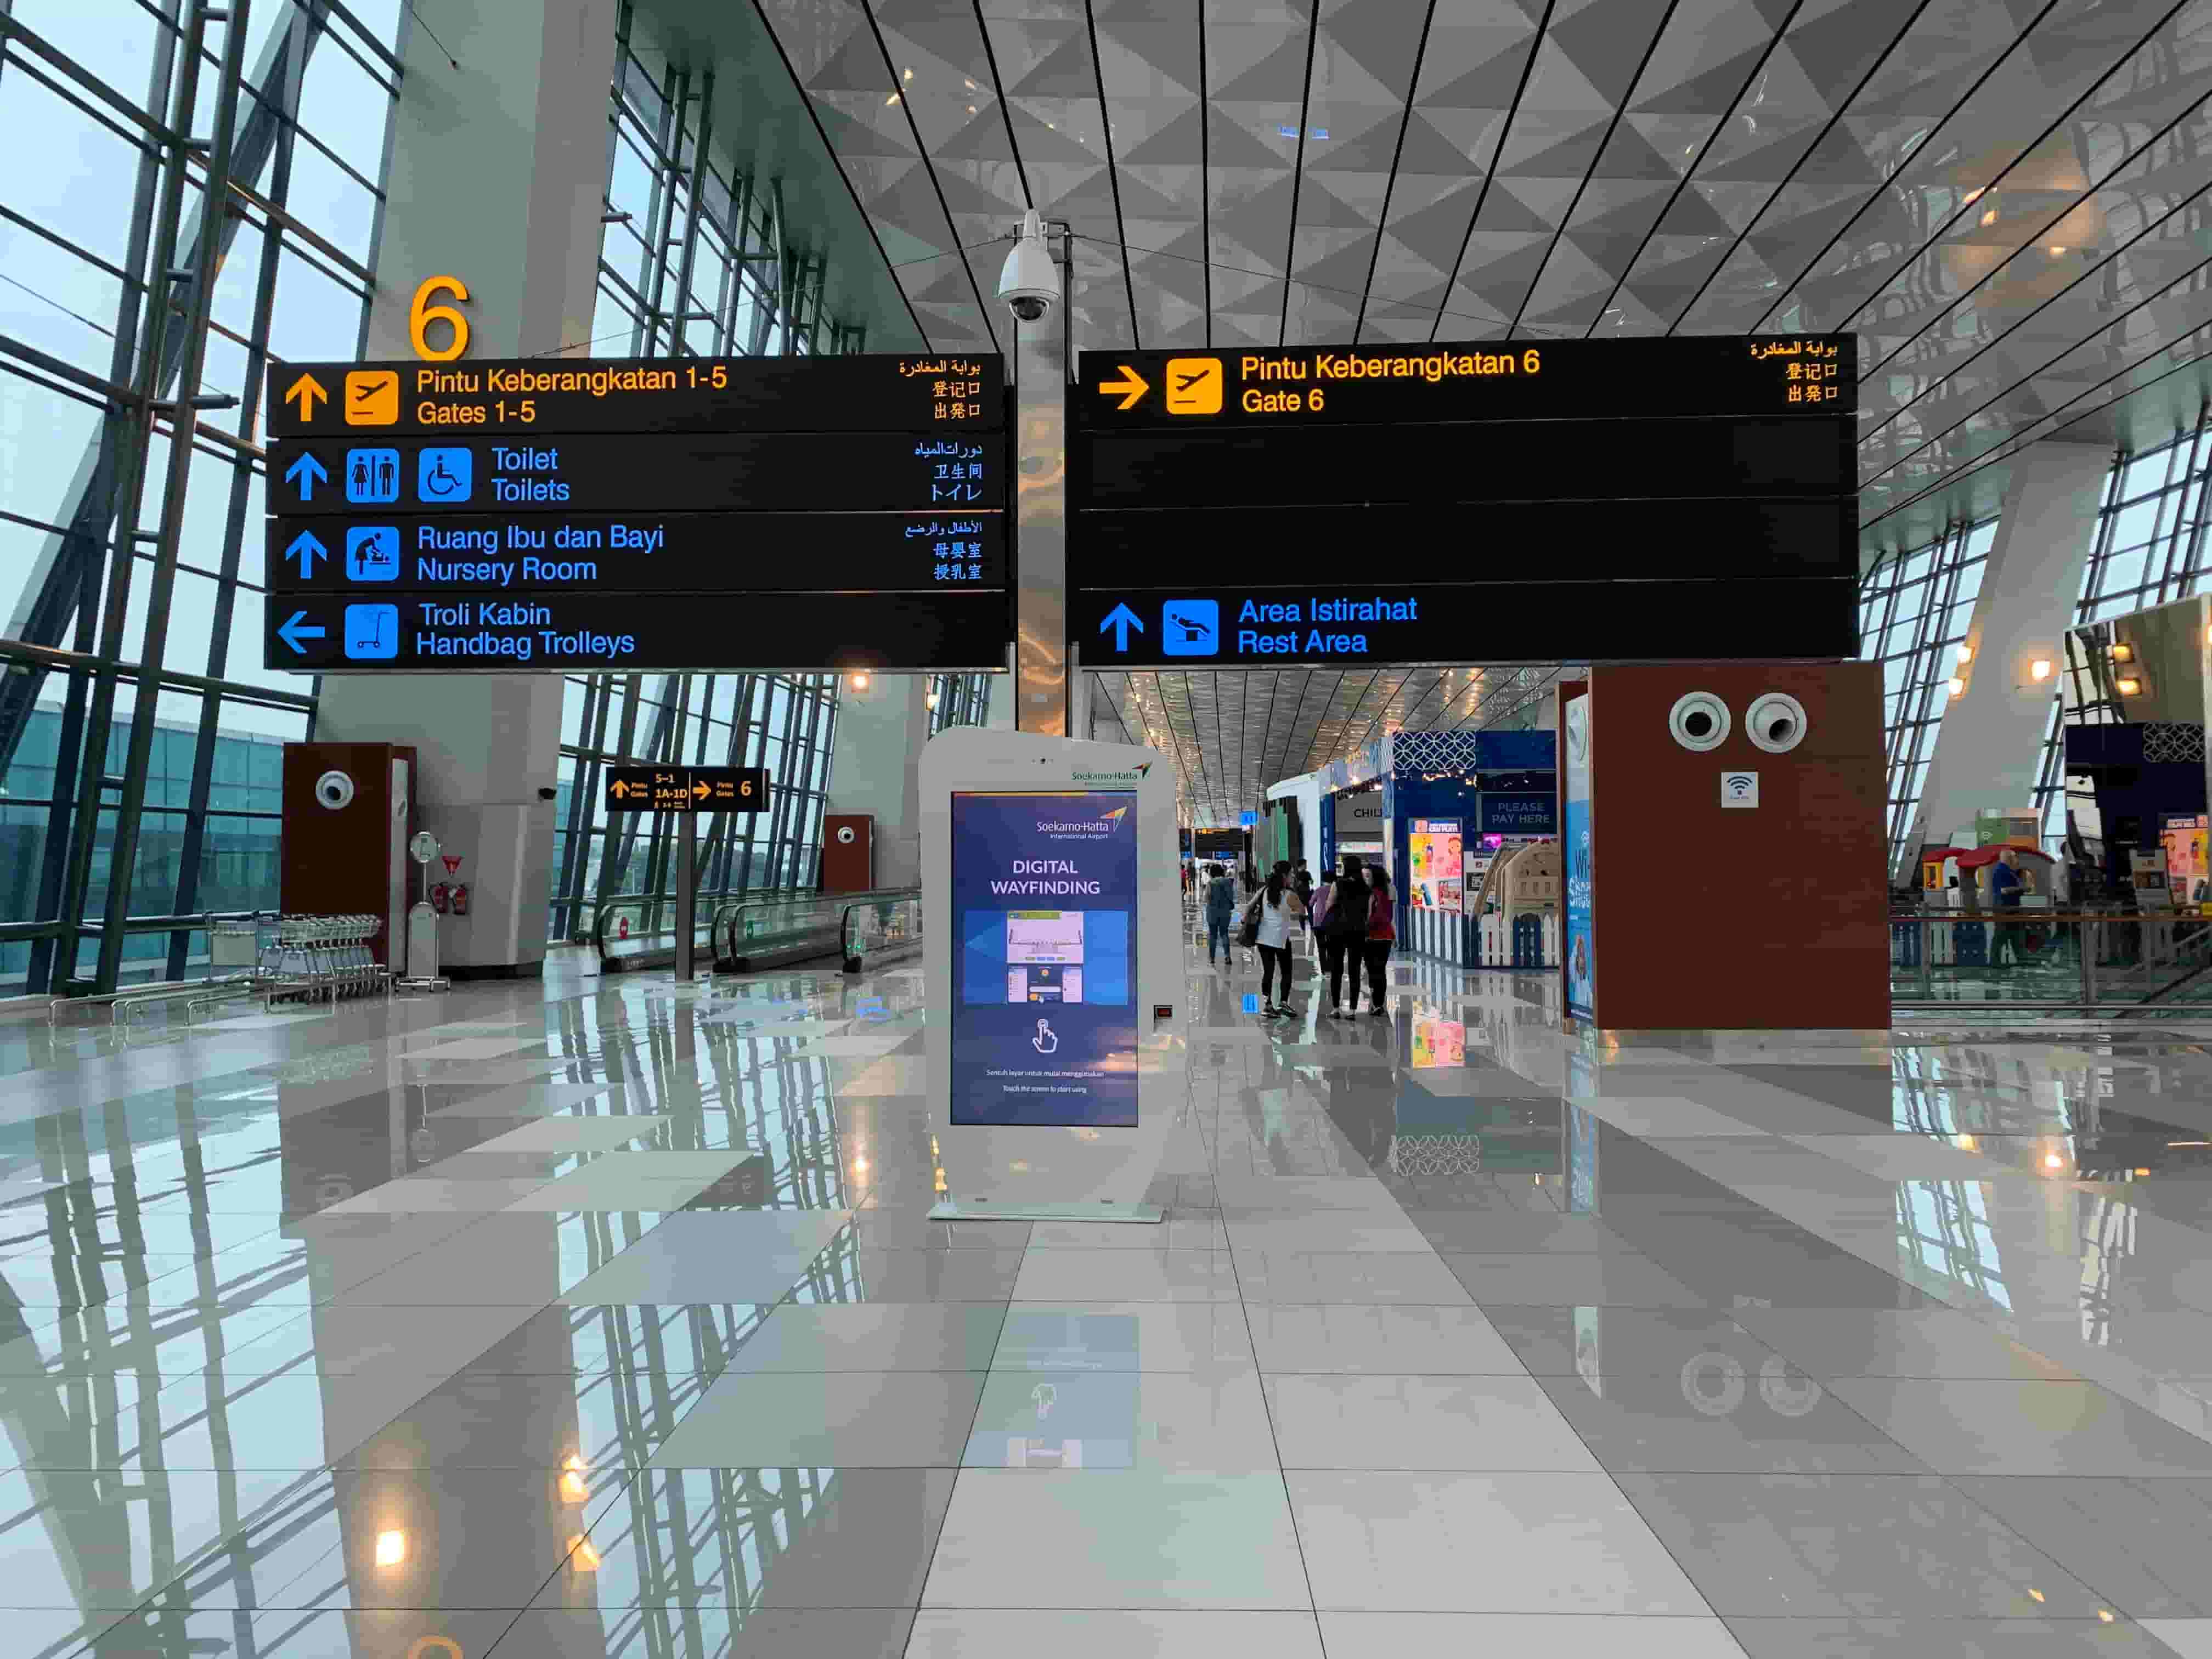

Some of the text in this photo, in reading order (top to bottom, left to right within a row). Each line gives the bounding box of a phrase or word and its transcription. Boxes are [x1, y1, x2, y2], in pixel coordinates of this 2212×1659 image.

[410, 275, 470, 362] 6
[1751, 341, 1837, 359] بوابة المغادرة
[900, 360, 980, 376] بوابة المغادرة
[1242, 349, 1539, 382] Pintu Keberangkatan 6
[1786, 363, 1837, 380] 登记口
[418, 366, 726, 396] Pintu Keberangkatan 1-5
[933, 380, 980, 398] 登记口
[1243, 388, 1324, 413] Gate 6
[1788, 385, 1837, 402] 出発口
[418, 400, 535, 424] Gates 1-5
[935, 402, 980, 419] 出発口
[492, 448, 557, 470] Toilet
[934, 463, 981, 478] 卫生间
[492, 478, 569, 500] Toilets
[932, 483, 981, 501] トイレ
[419, 525, 663, 554] Ruang Ibu dan Bayi
[419, 557, 596, 586] Nursery Room
[419, 603, 550, 625] Troli Kabin
[1239, 597, 1417, 622] Area Istirahat
[417, 631, 634, 660] Handbag Trolleys
[1238, 629, 1368, 653] Rest Area
[741, 781, 751, 795] 6
[1498, 803, 1545, 811] PLEASE
[1036, 821, 1108, 832] Soekarno-Hatta
[1492, 814, 1549, 824] PAY HERE
[1013, 860, 1078, 873] DIGITAL
[991, 881, 1100, 895] WAYFINDING
